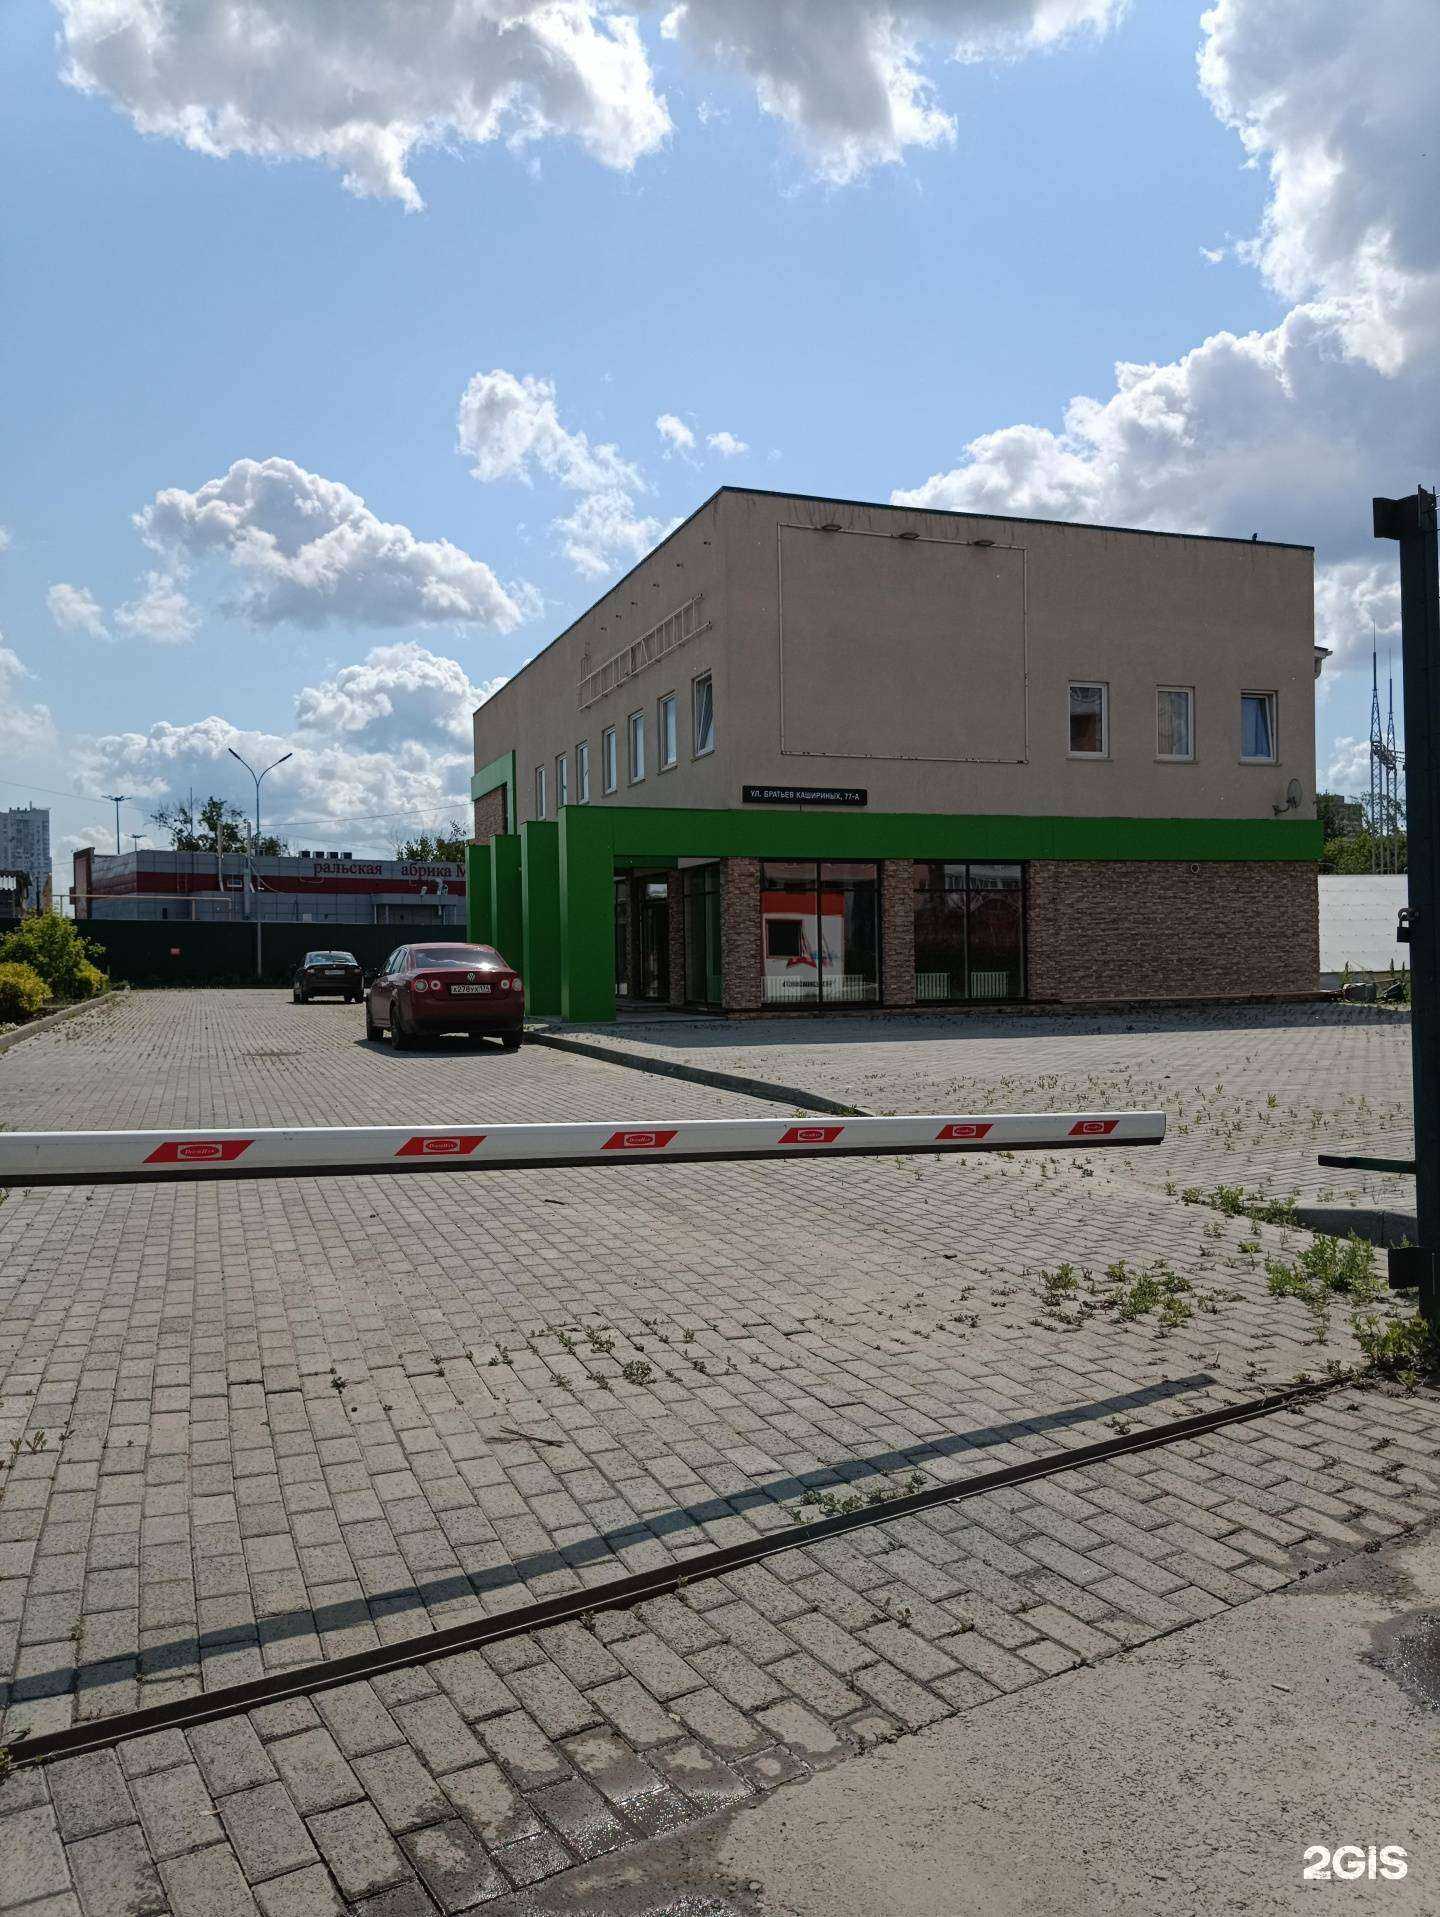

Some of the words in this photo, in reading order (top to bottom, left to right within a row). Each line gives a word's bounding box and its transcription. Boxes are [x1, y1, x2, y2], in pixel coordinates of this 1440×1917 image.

[750, 790, 762, 798] УЛ.
[763, 790, 794, 799] БРАТЬЕВ
[796, 791, 843, 801] КАШИРИНЫХ,
[844, 793, 860, 801] 77-А
[313, 861, 382, 876] ральская
[401, 862, 451, 879] абрика
